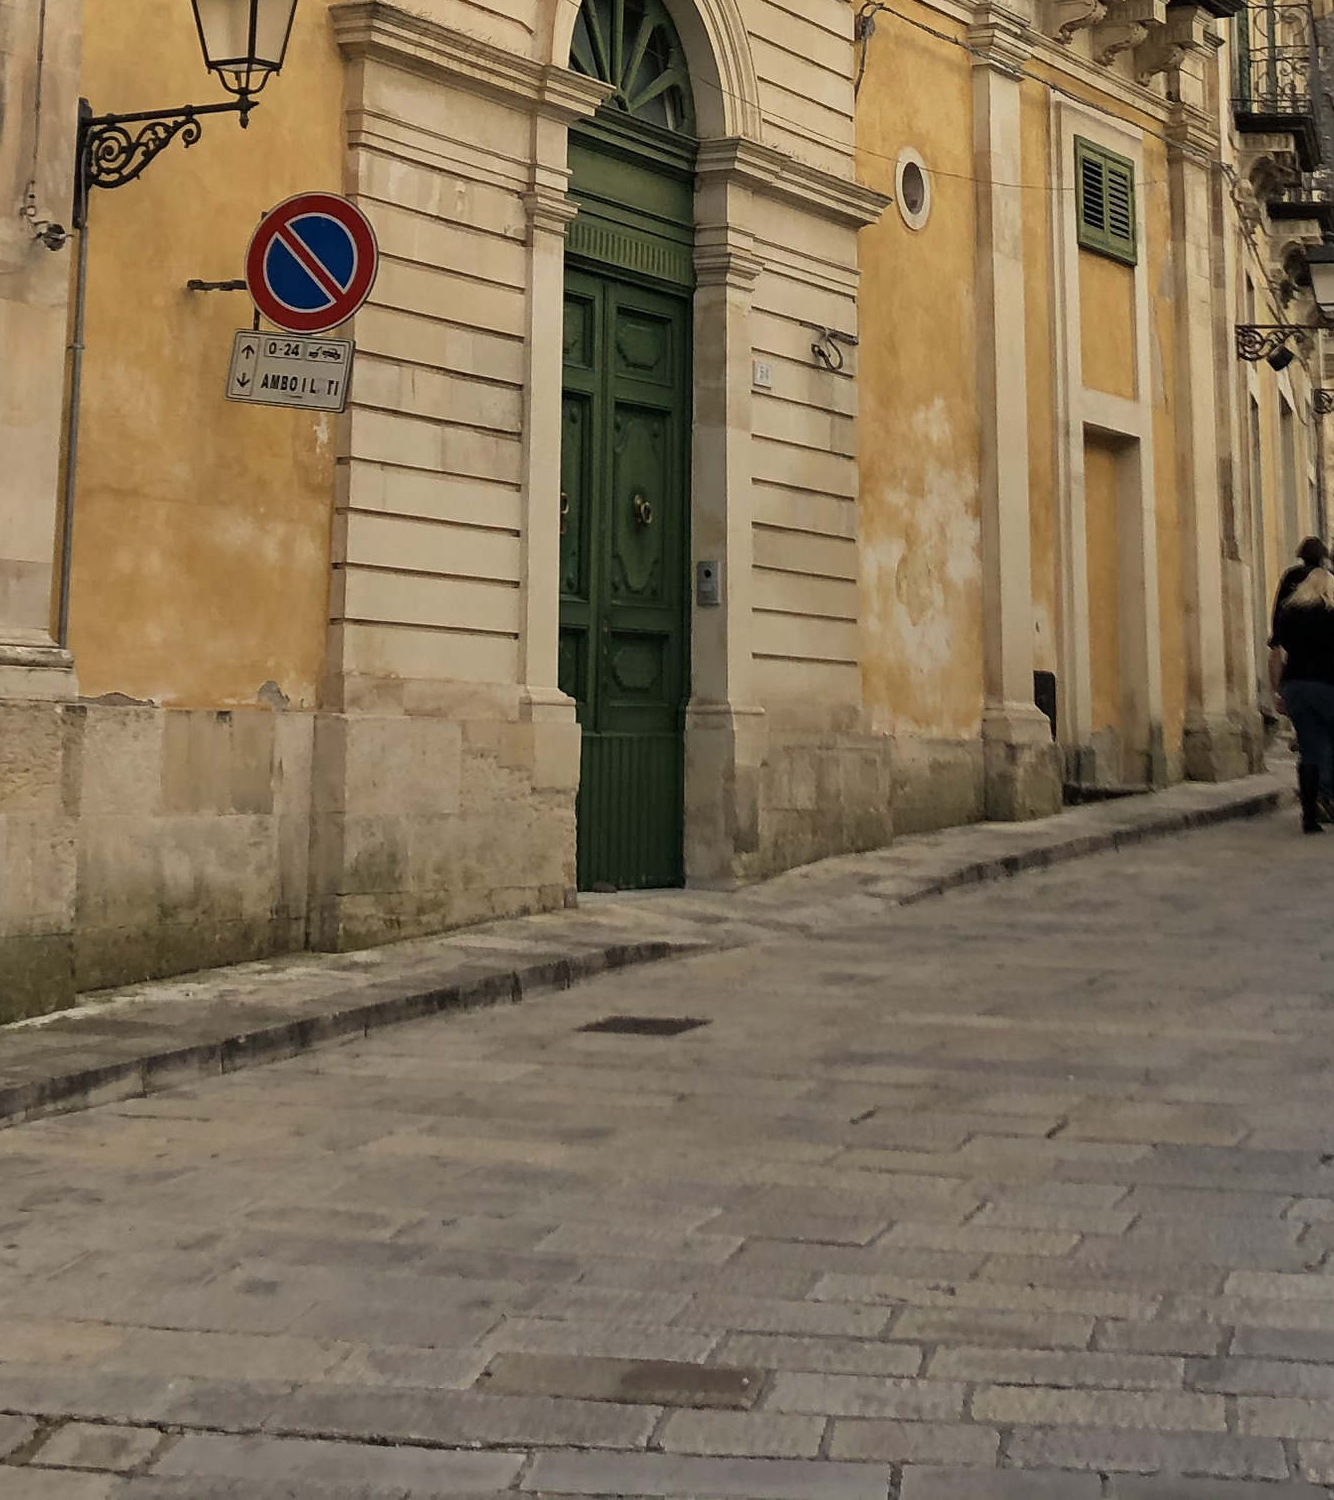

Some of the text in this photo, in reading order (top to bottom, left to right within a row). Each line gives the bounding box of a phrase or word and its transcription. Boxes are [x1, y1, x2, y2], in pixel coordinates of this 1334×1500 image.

[269, 342, 300, 356] 0-24
[260, 373, 298, 391] AMBO
[309, 378, 339, 396] LTI
